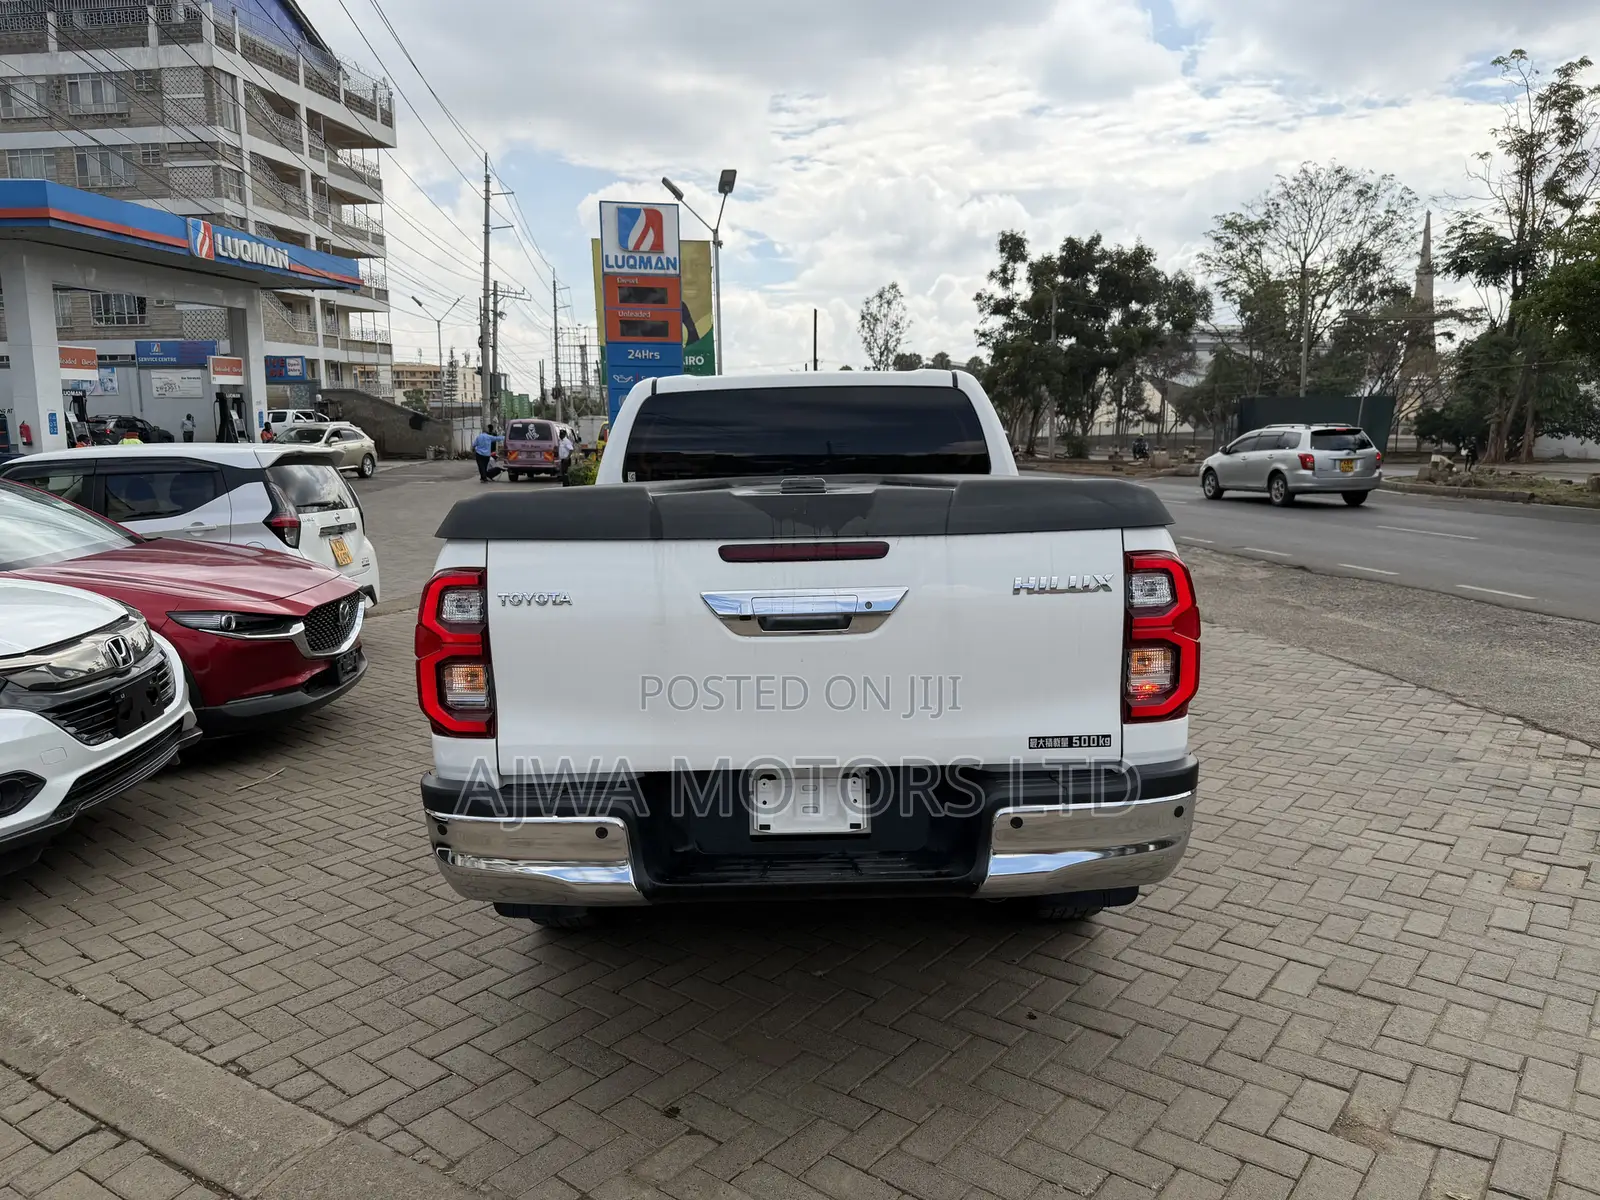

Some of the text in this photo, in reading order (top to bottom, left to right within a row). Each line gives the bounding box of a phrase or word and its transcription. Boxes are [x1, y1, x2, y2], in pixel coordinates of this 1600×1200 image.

[214, 233, 289, 269] LUQMAN
[604, 254, 678, 270] LUQMAN
[616, 276, 639, 284] Diesel
[618, 310, 651, 318] Unleaded
[627, 349, 660, 360] 24Hrs
[683, 355, 705, 366] IRO
[1012, 573, 1114, 595] HILUX
[497, 591, 573, 607] TOYOTA
[1072, 735, 1111, 747] 500kg
